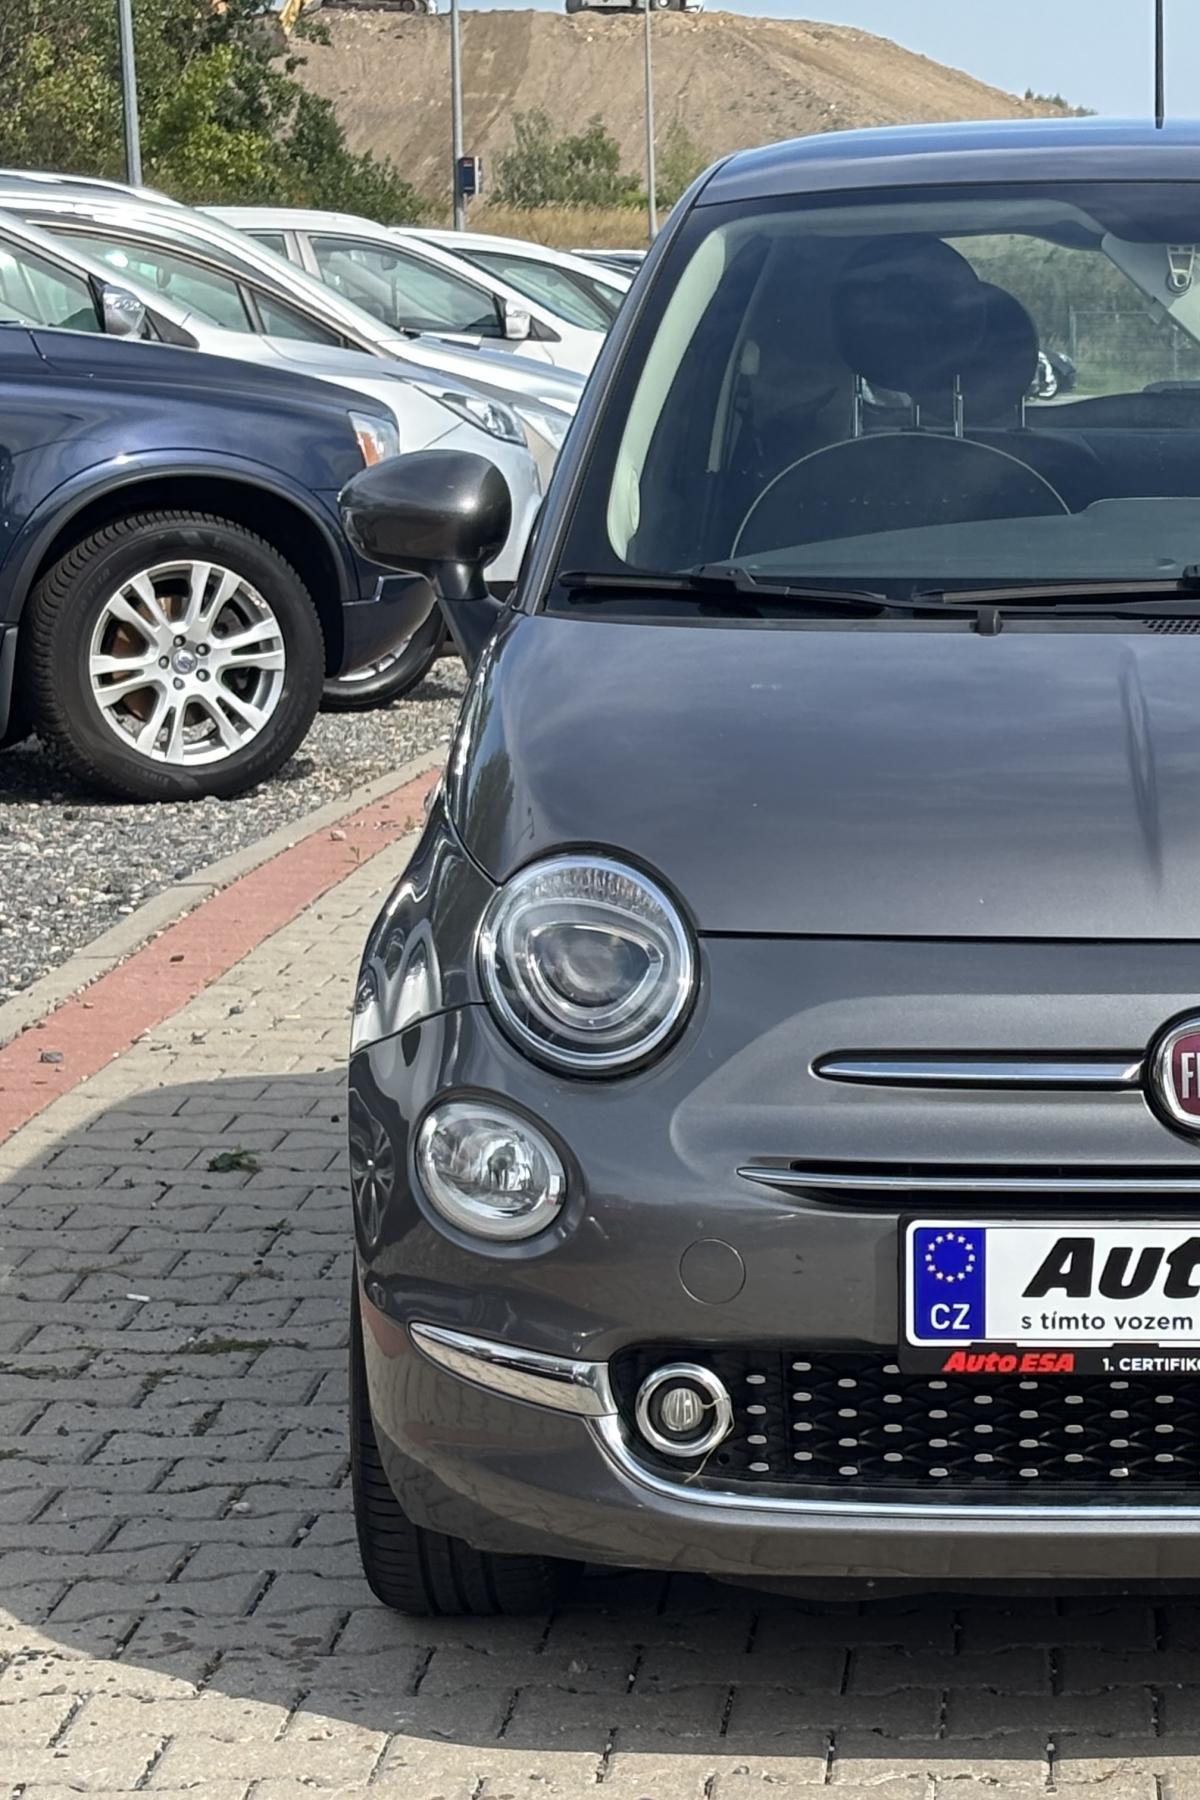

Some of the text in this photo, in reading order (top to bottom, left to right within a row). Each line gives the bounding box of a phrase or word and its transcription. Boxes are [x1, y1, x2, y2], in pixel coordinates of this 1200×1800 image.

[930, 1303, 970, 1330] CZ
[1021, 1314, 1032, 1330] s
[1041, 1311, 1105, 1331] tímto
[1114, 1314, 1193, 1331] vozem
[942, 1351, 1074, 1373] Auto ESA
[1102, 1357, 1114, 1372] 1.
